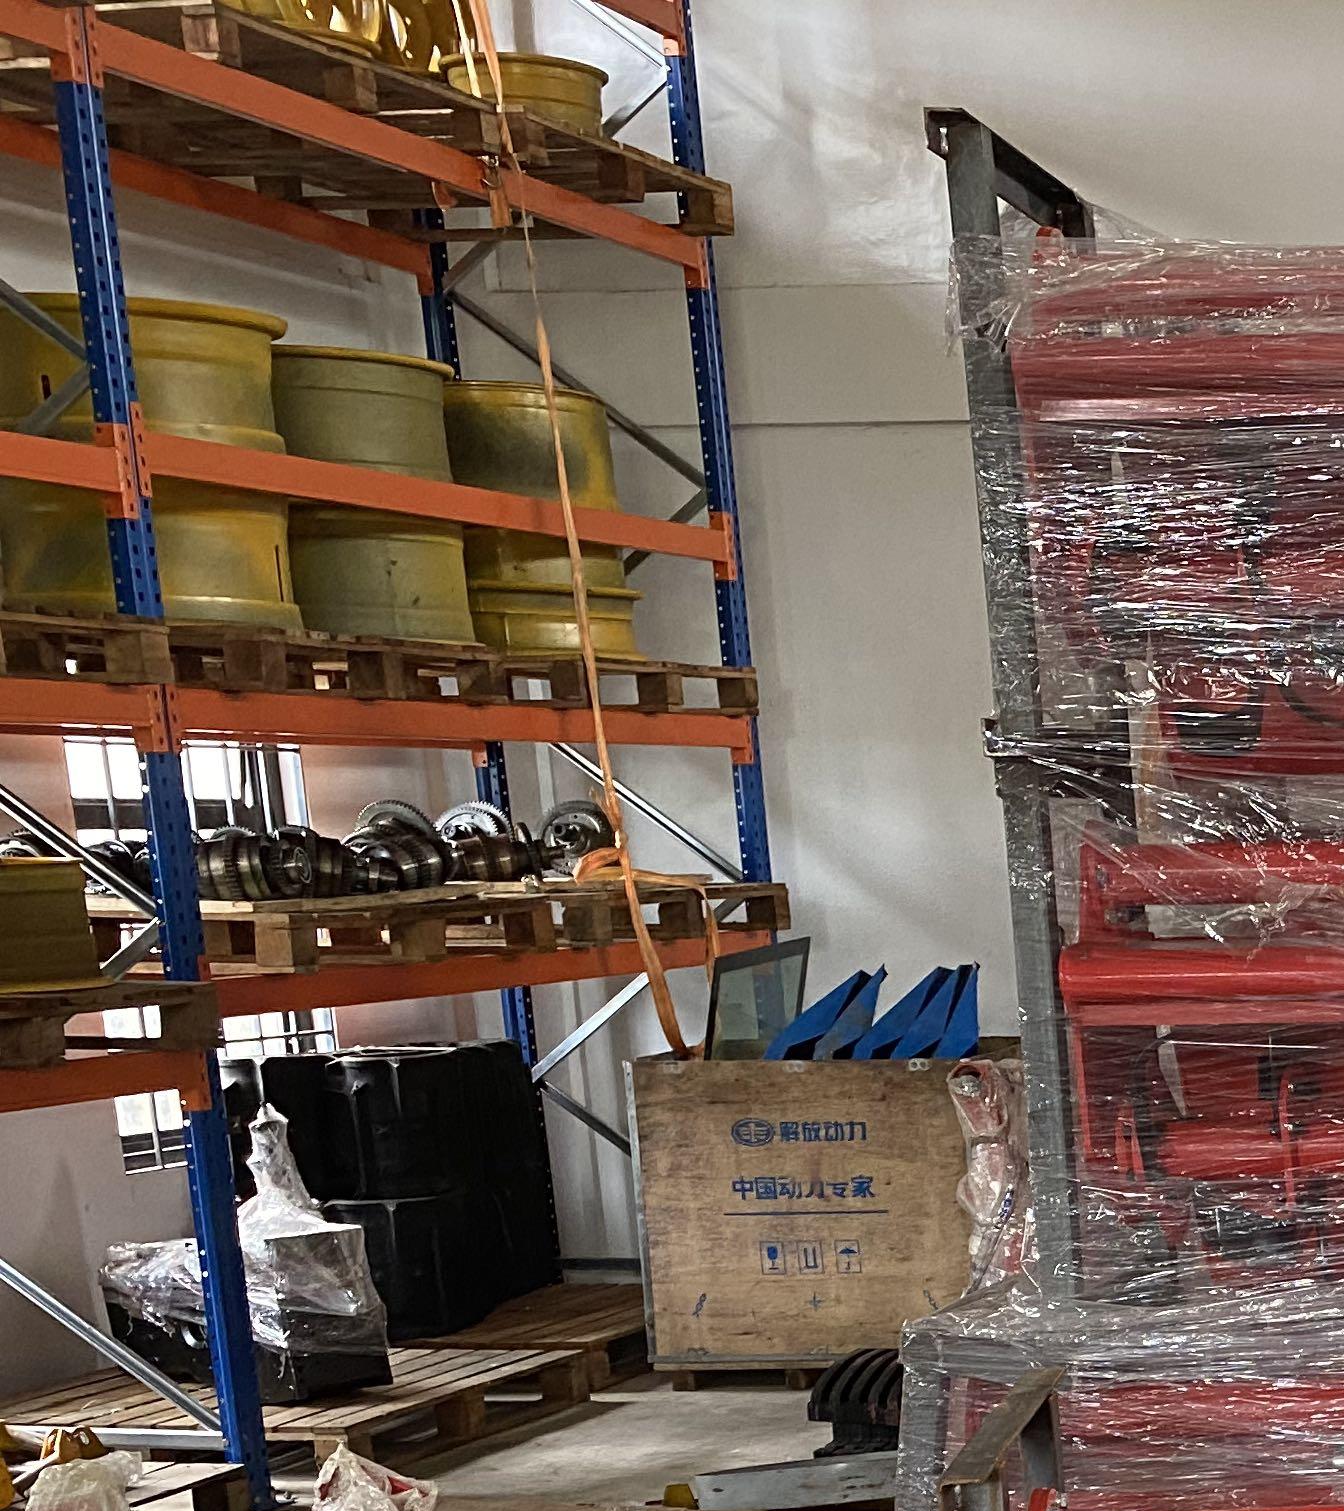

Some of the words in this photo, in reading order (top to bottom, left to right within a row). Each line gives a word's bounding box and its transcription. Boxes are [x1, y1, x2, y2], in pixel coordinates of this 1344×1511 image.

[731, 1173, 876, 1201] 中国动力专家
